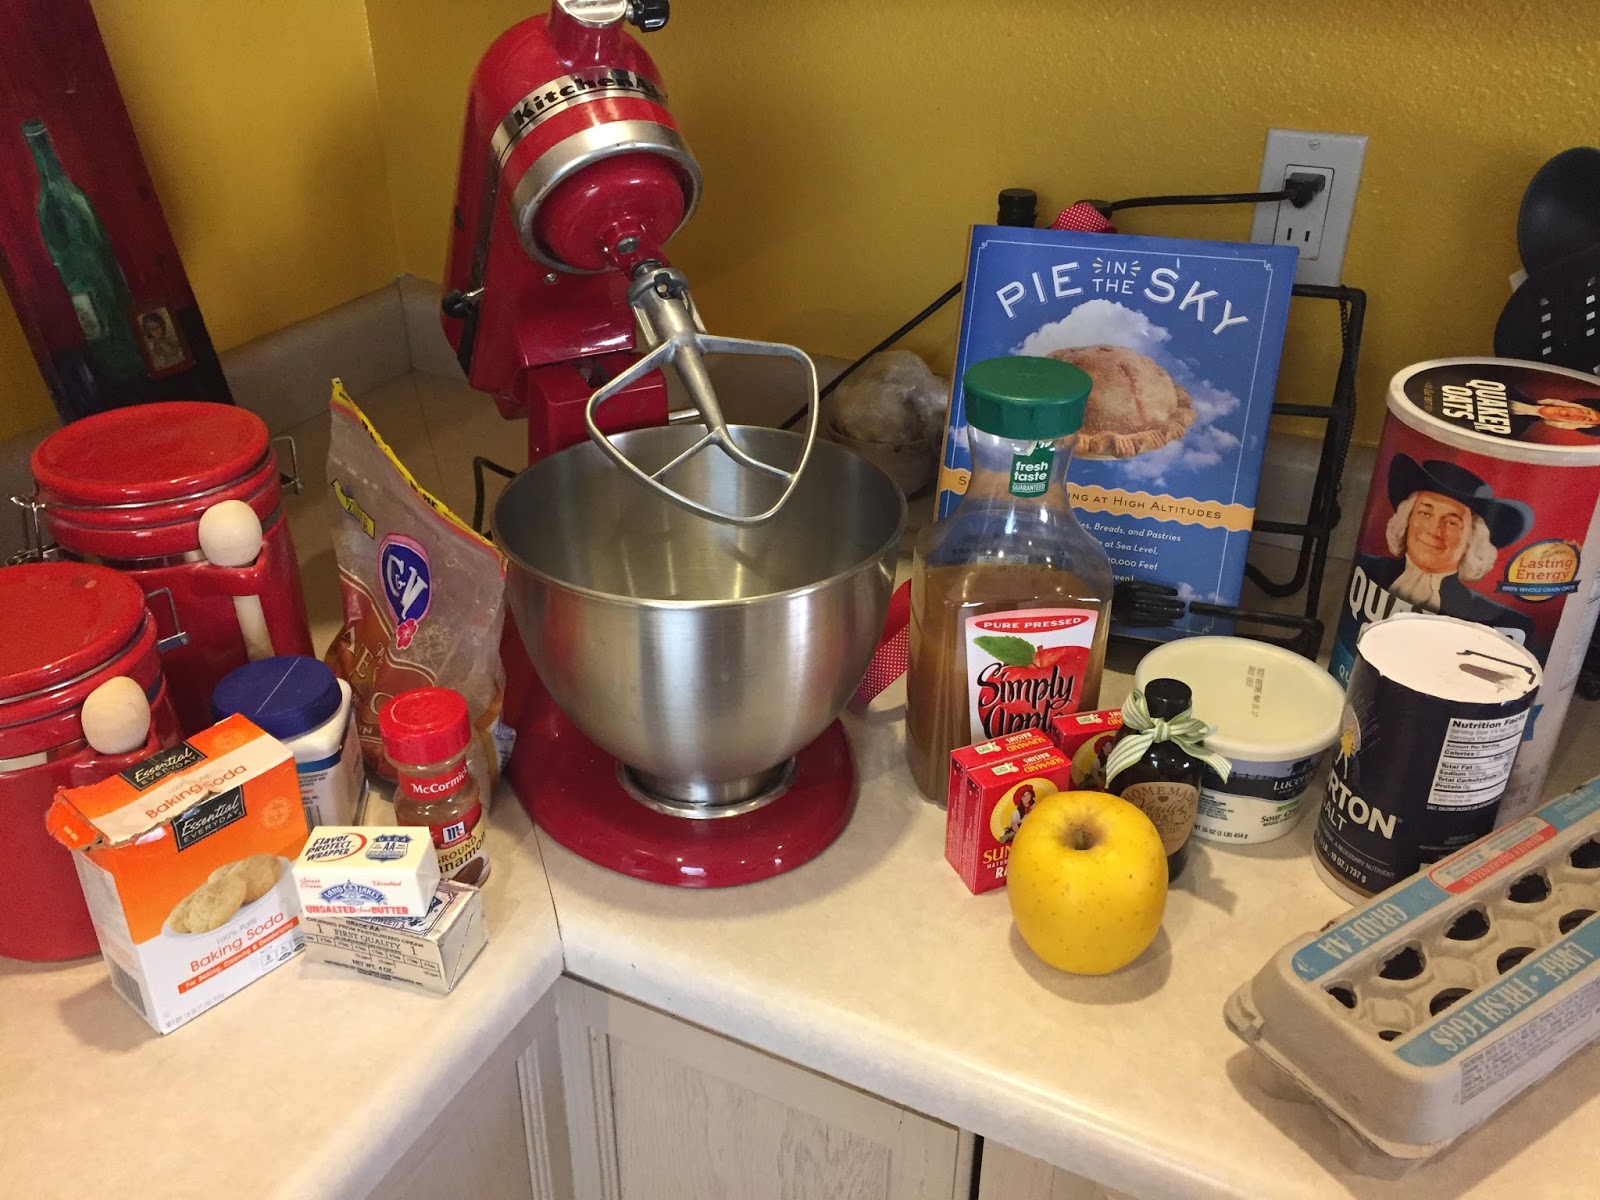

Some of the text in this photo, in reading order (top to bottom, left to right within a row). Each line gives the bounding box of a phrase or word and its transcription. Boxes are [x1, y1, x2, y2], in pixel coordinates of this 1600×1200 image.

[513, 77, 668, 127] KitchenA
[997, 261, 1249, 336] PIE IN THE SKY
[1441, 385, 1475, 421] OATS
[1465, 379, 1512, 435] QUAKER
[1015, 461, 1049, 472] fresh
[1012, 482, 1046, 492] GUARANTEED
[1013, 472, 1048, 482] taste
[1150, 501, 1222, 520] ALTITUDES
[1128, 528, 1145, 537] and
[1146, 530, 1182, 543] Pastries
[1104, 541, 1114, 549] at
[1115, 541, 1132, 551] Sea
[1138, 560, 1159, 571] Feet
[1518, 557, 1574, 570] Lasting
[1515, 568, 1572, 583] Energy
[983, 617, 1082, 629] PURE PRESSED
[977, 662, 1075, 710] Simply
[984, 699, 1063, 740] Appl
[1452, 713, 1526, 729] Nutrition Facts
[134, 747, 193, 783] Essential
[141, 755, 197, 786] EVERYDAY
[411, 765, 468, 795] McCormic
[145, 783, 203, 819] Baking
[1328, 768, 1397, 840] RTON
[181, 794, 240, 838] Essential
[183, 808, 240, 843] EVERYDAY
[1323, 800, 1348, 832] ALT
[312, 834, 350, 847] Flavor
[382, 842, 396, 852] AA
[306, 848, 350, 862] WRAPPER
[1365, 861, 1396, 878] NUTRIENT
[323, 886, 344, 899] LAND
[358, 886, 383, 899] LAKES
[305, 905, 356, 915] UNSALTED
[371, 905, 409, 916] BUTTER
[334, 928, 358, 940] FIRST
[360, 935, 401, 950] QUALITY
[1317, 902, 1409, 960] GRADE AA
[190, 937, 243, 973] Baking
[246, 912, 285, 941] Soda
[185, 979, 198, 989] For
[1430, 940, 1596, 1052] LARGE FRESH EGGS
